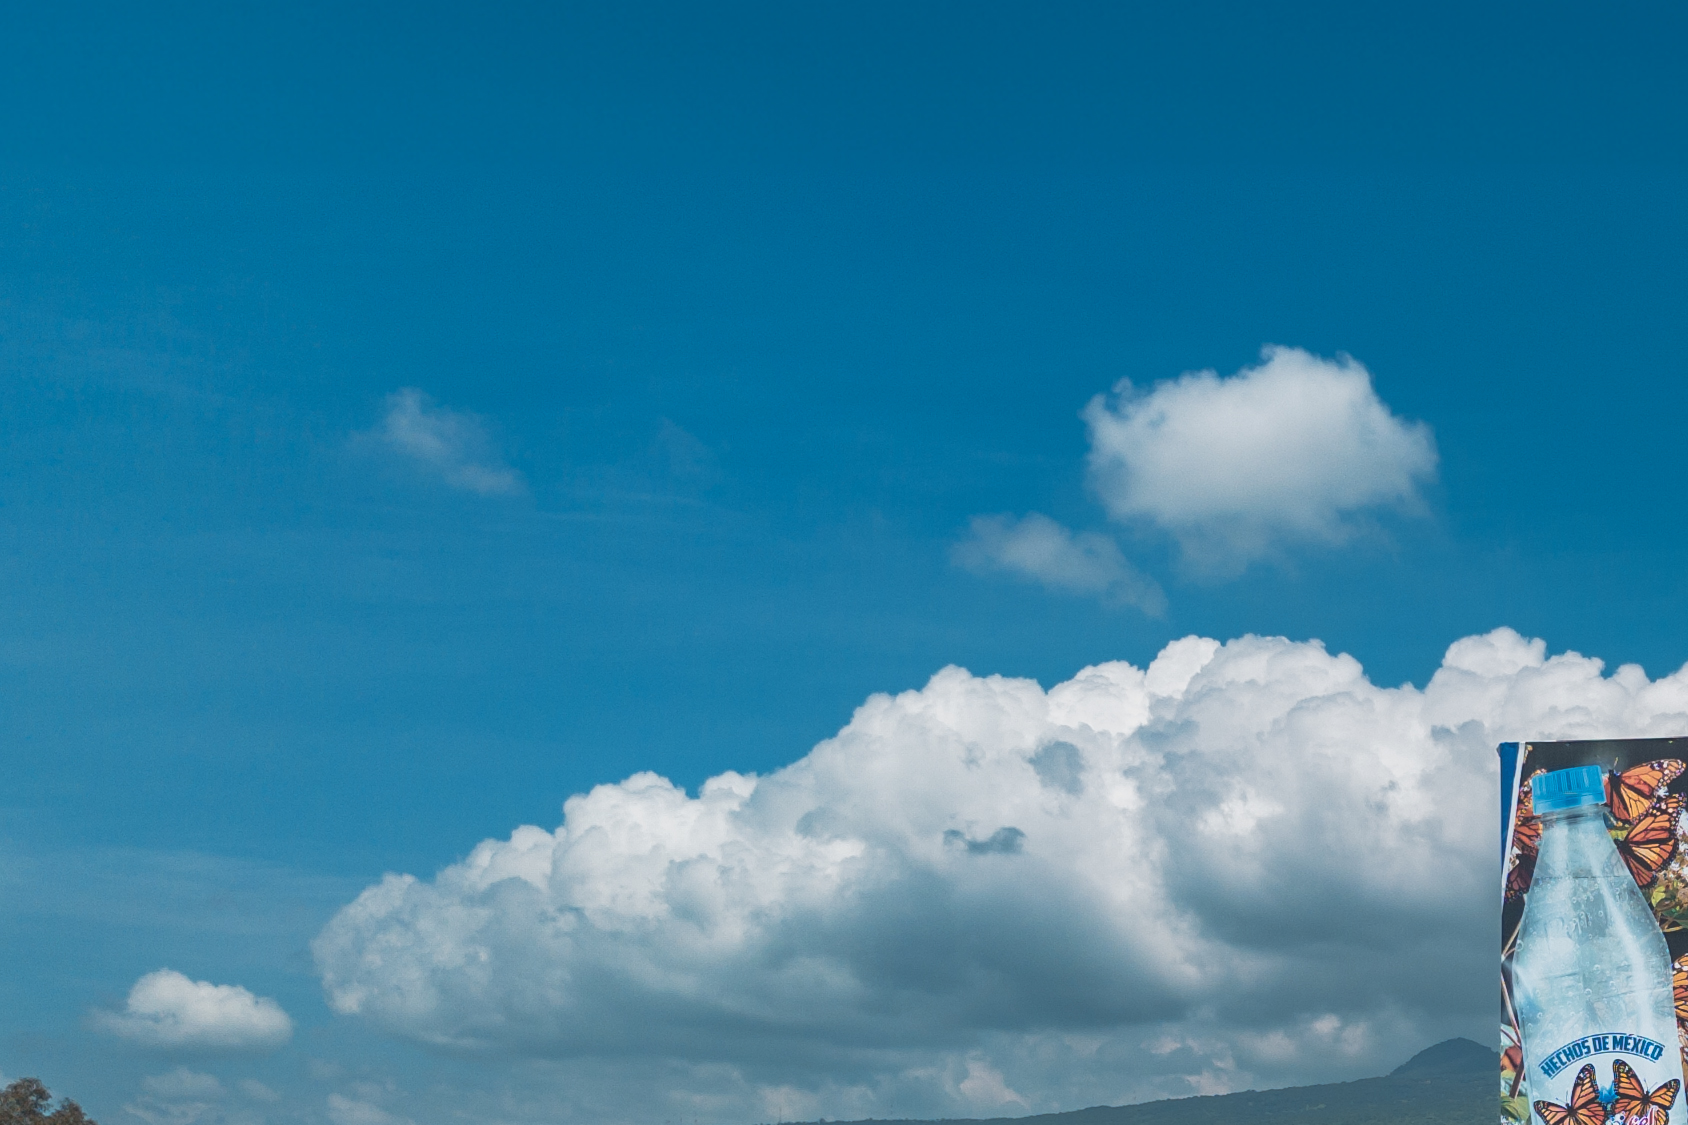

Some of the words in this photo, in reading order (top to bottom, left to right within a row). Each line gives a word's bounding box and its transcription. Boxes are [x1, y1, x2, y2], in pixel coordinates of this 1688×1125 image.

[1541, 1038, 1590, 1076] HECHOS
[1593, 1035, 1610, 1051] DE
[1612, 1033, 1665, 1061] MÉXICO
